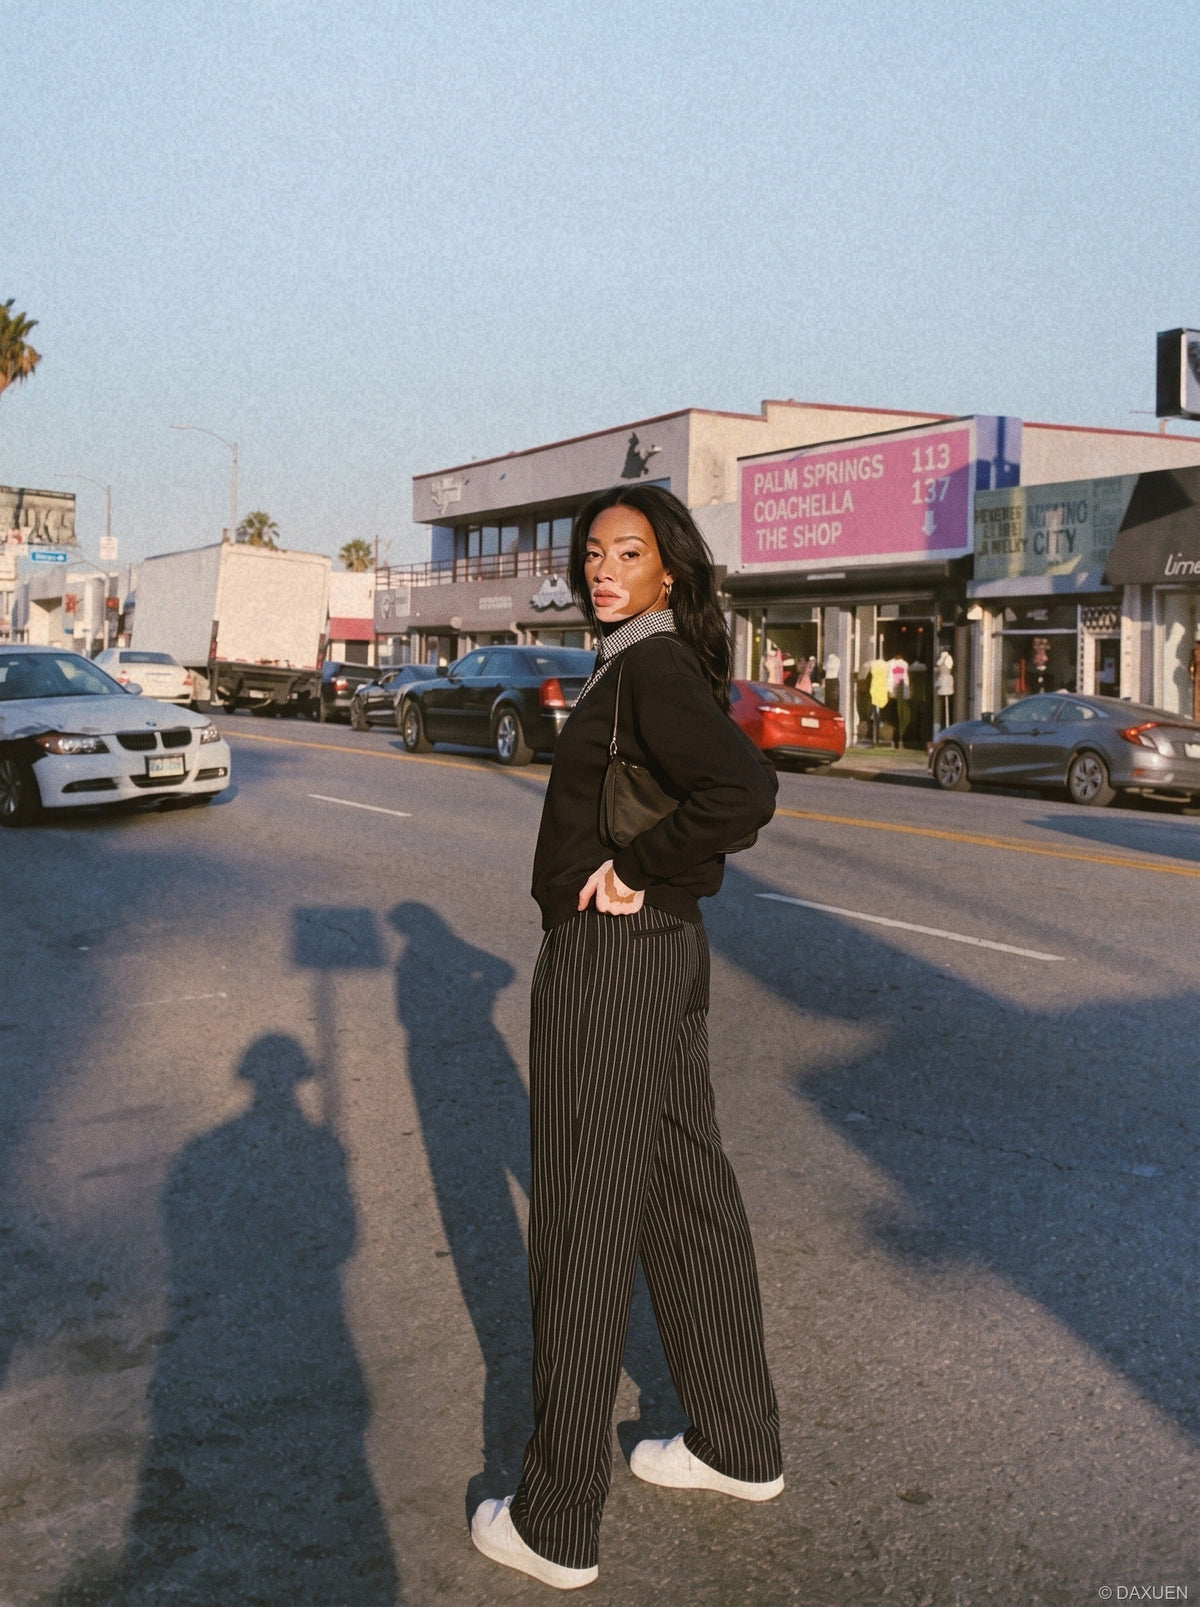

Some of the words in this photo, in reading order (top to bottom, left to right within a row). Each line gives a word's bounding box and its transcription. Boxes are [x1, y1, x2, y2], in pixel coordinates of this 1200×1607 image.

[911, 443, 950, 474] 113
[754, 467, 798, 496] PALM
[802, 454, 884, 489] SPRINGS
[911, 476, 950, 505] 137
[754, 489, 854, 523] COACHELLA
[756, 526, 788, 551] THE
[793, 521, 843, 548] SHOP
[1033, 527, 1076, 555] CITY
